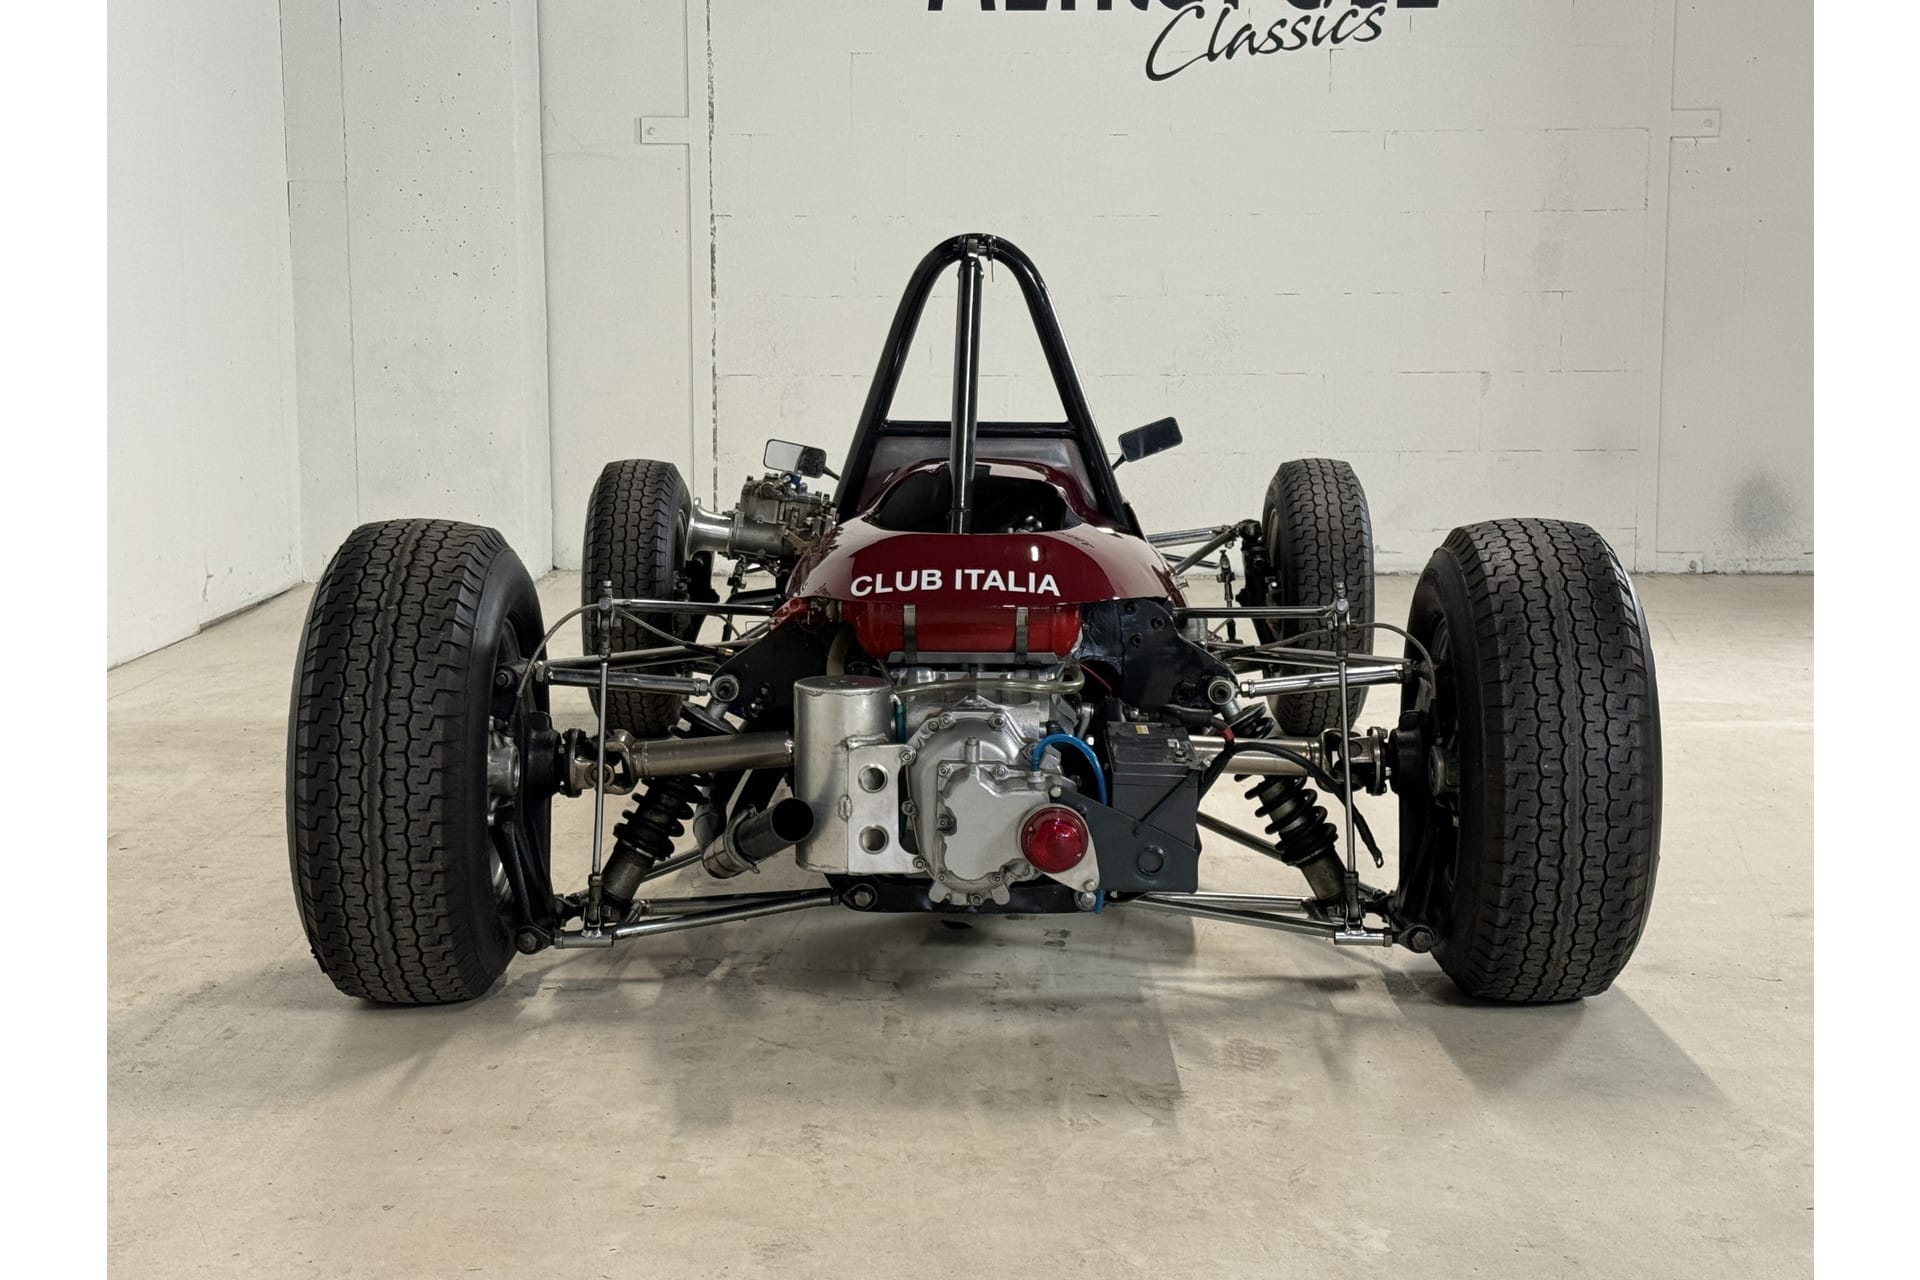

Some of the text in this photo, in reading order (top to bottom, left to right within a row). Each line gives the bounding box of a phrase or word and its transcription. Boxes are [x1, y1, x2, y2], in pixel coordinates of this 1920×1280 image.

[1145, 4, 1386, 82] Classics
[850, 569, 1062, 597] CLUB ITALIA
